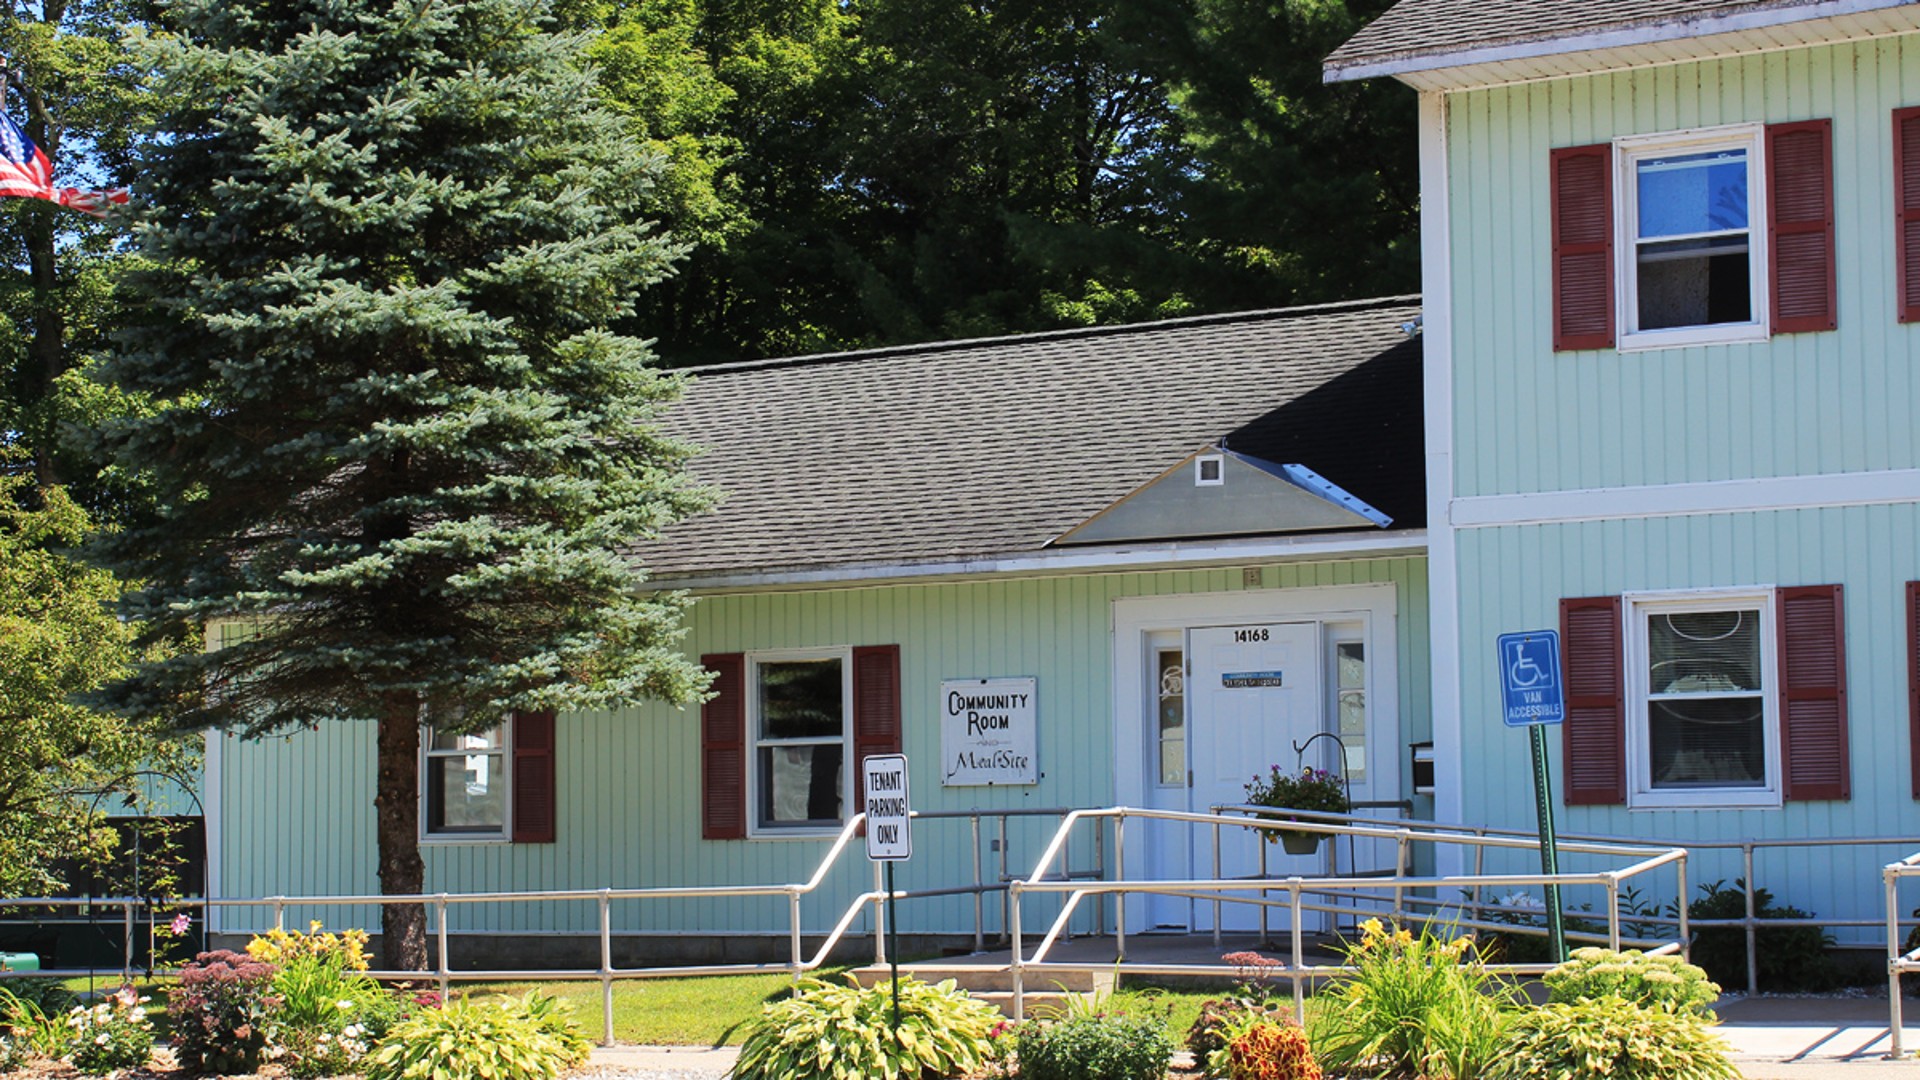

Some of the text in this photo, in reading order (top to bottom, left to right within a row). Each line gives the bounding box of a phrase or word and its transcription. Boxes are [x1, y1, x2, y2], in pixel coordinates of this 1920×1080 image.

[1234, 629, 1269, 642] 14168
[948, 690, 1028, 716] COMMUNITY
[1523, 691, 1542, 703] VAN
[1508, 704, 1560, 718] ACCESSIBLE
[967, 711, 1009, 736] ROOM
[869, 770, 901, 791] TENANT
[868, 798, 905, 818] PARKING
[877, 824, 899, 844] ONLY
